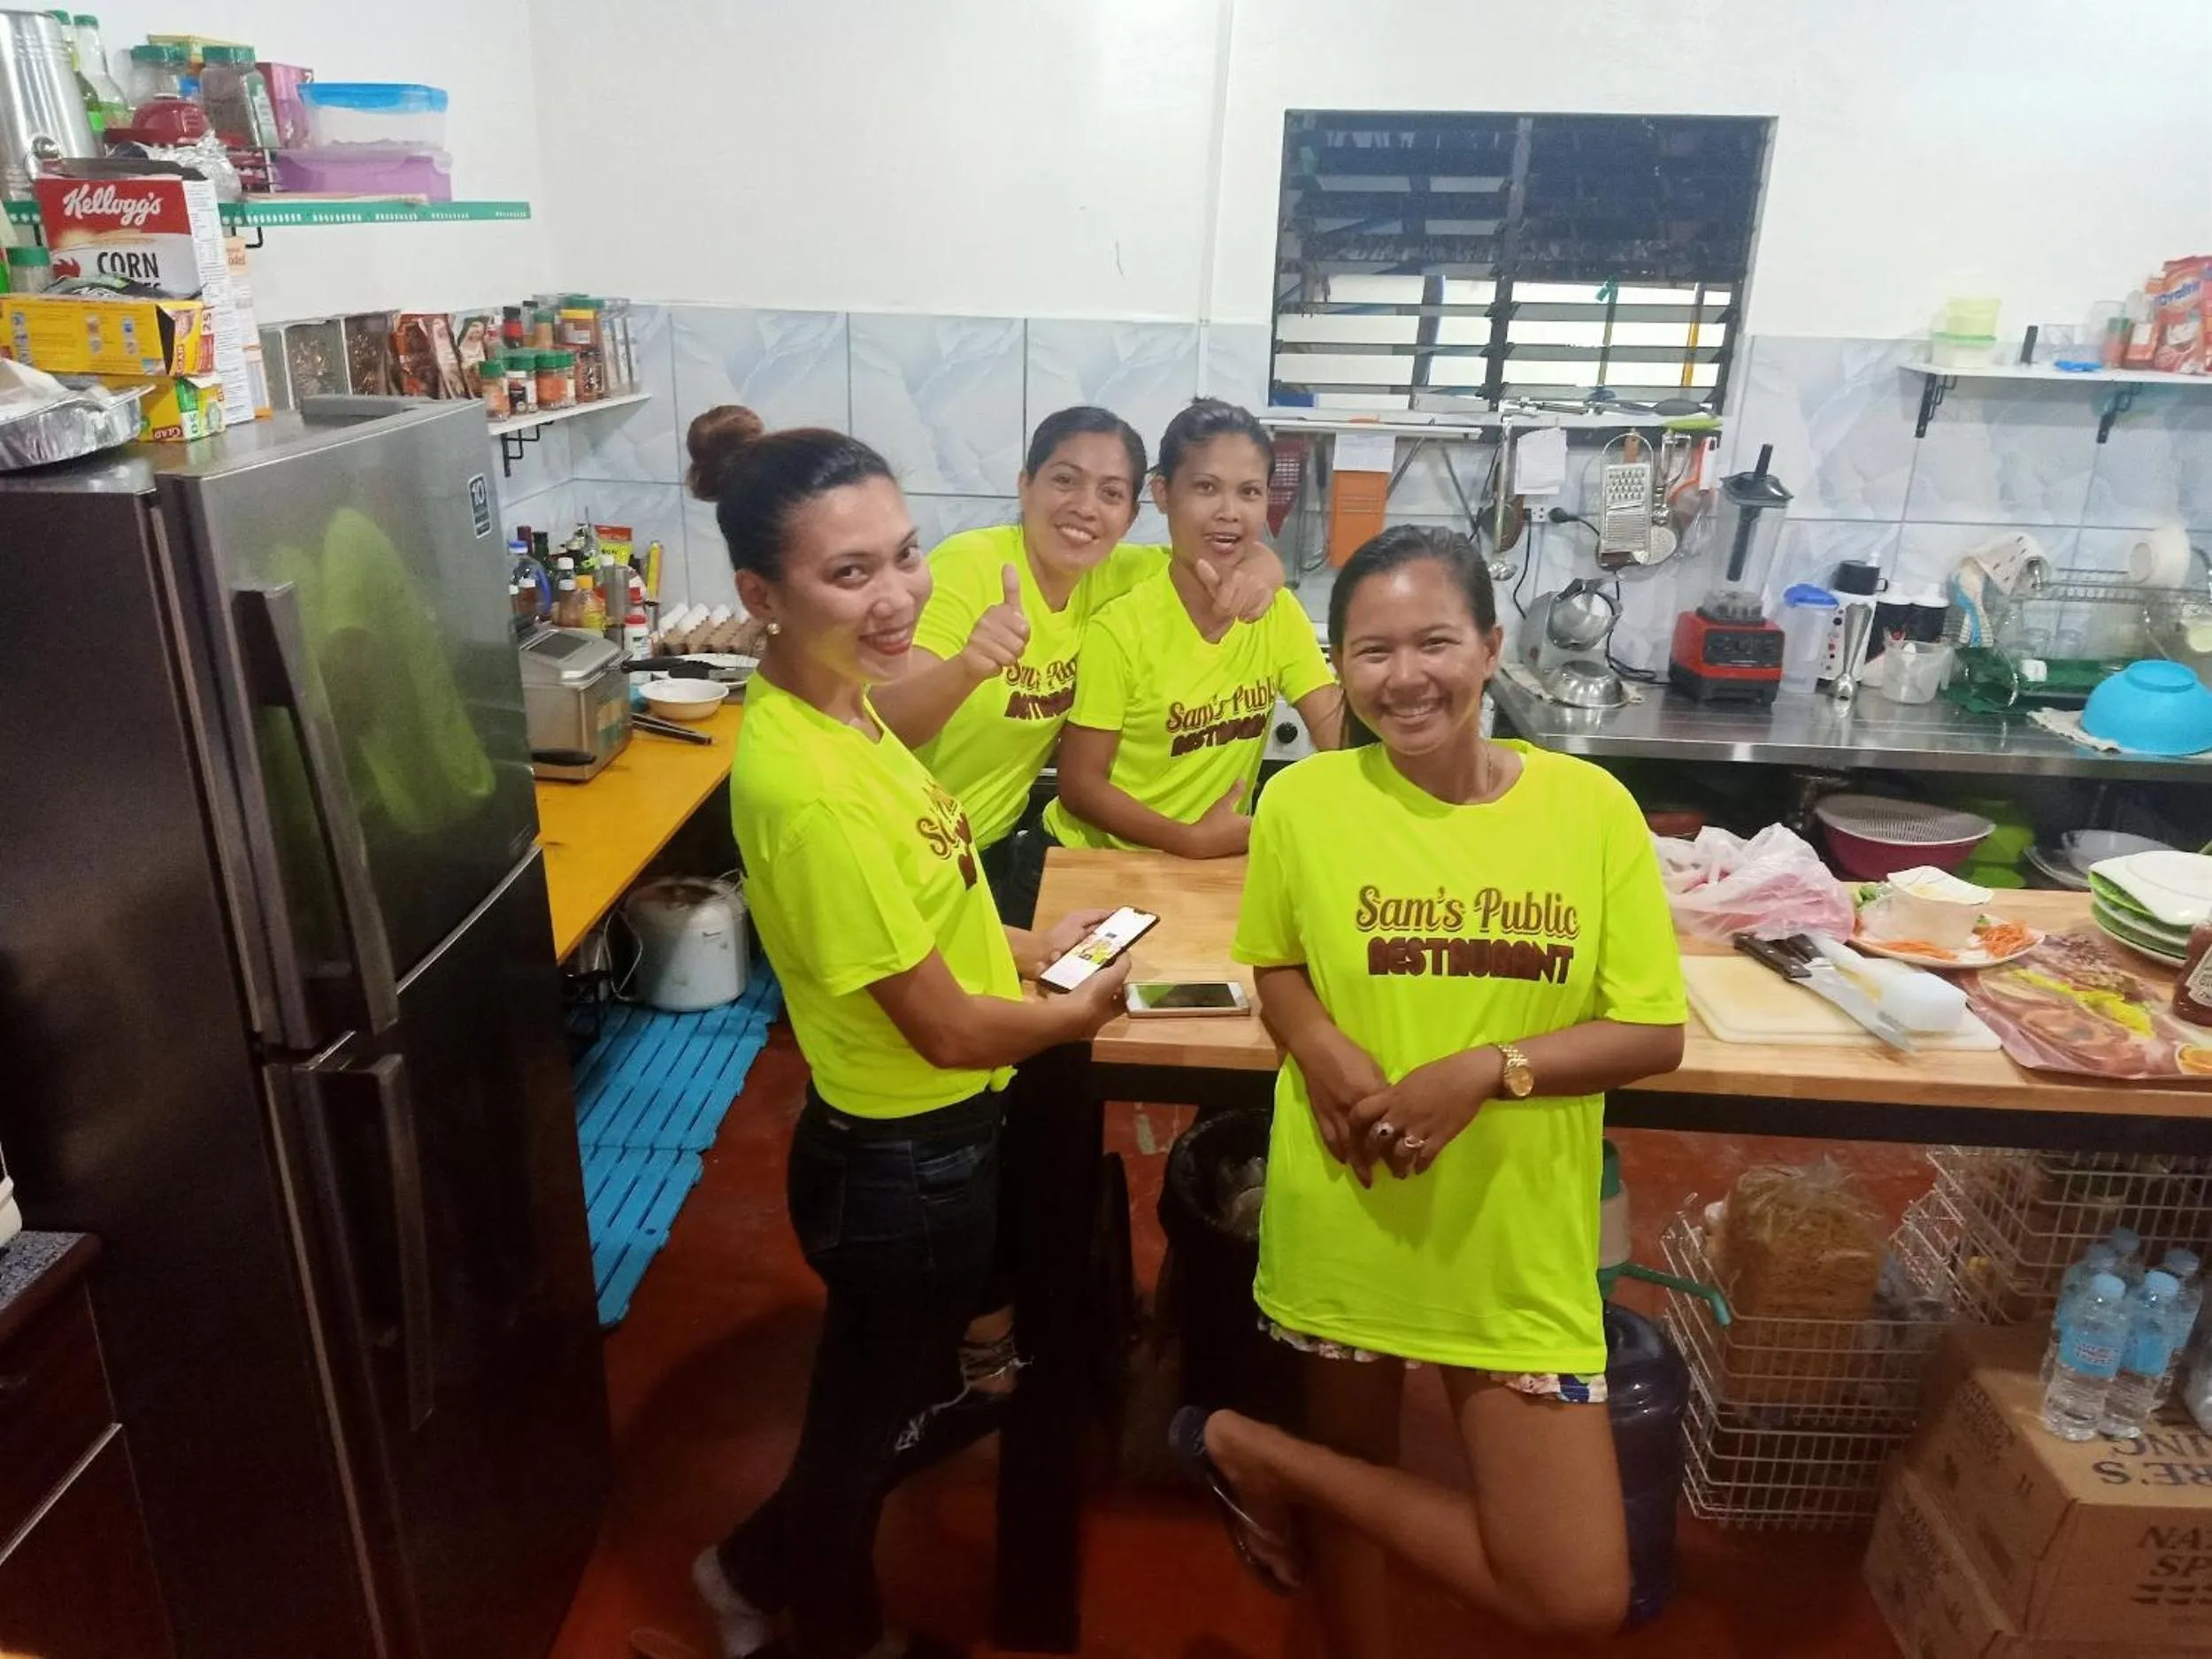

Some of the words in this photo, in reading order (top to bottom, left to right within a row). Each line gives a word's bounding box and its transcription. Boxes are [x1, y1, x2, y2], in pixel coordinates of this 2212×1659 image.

[63, 184, 163, 227] Kellogg's
[96, 251, 160, 278] CORN
[471, 480, 485, 505] 10
[1356, 884, 1466, 933] Sam's
[1474, 887, 1581, 940] Public
